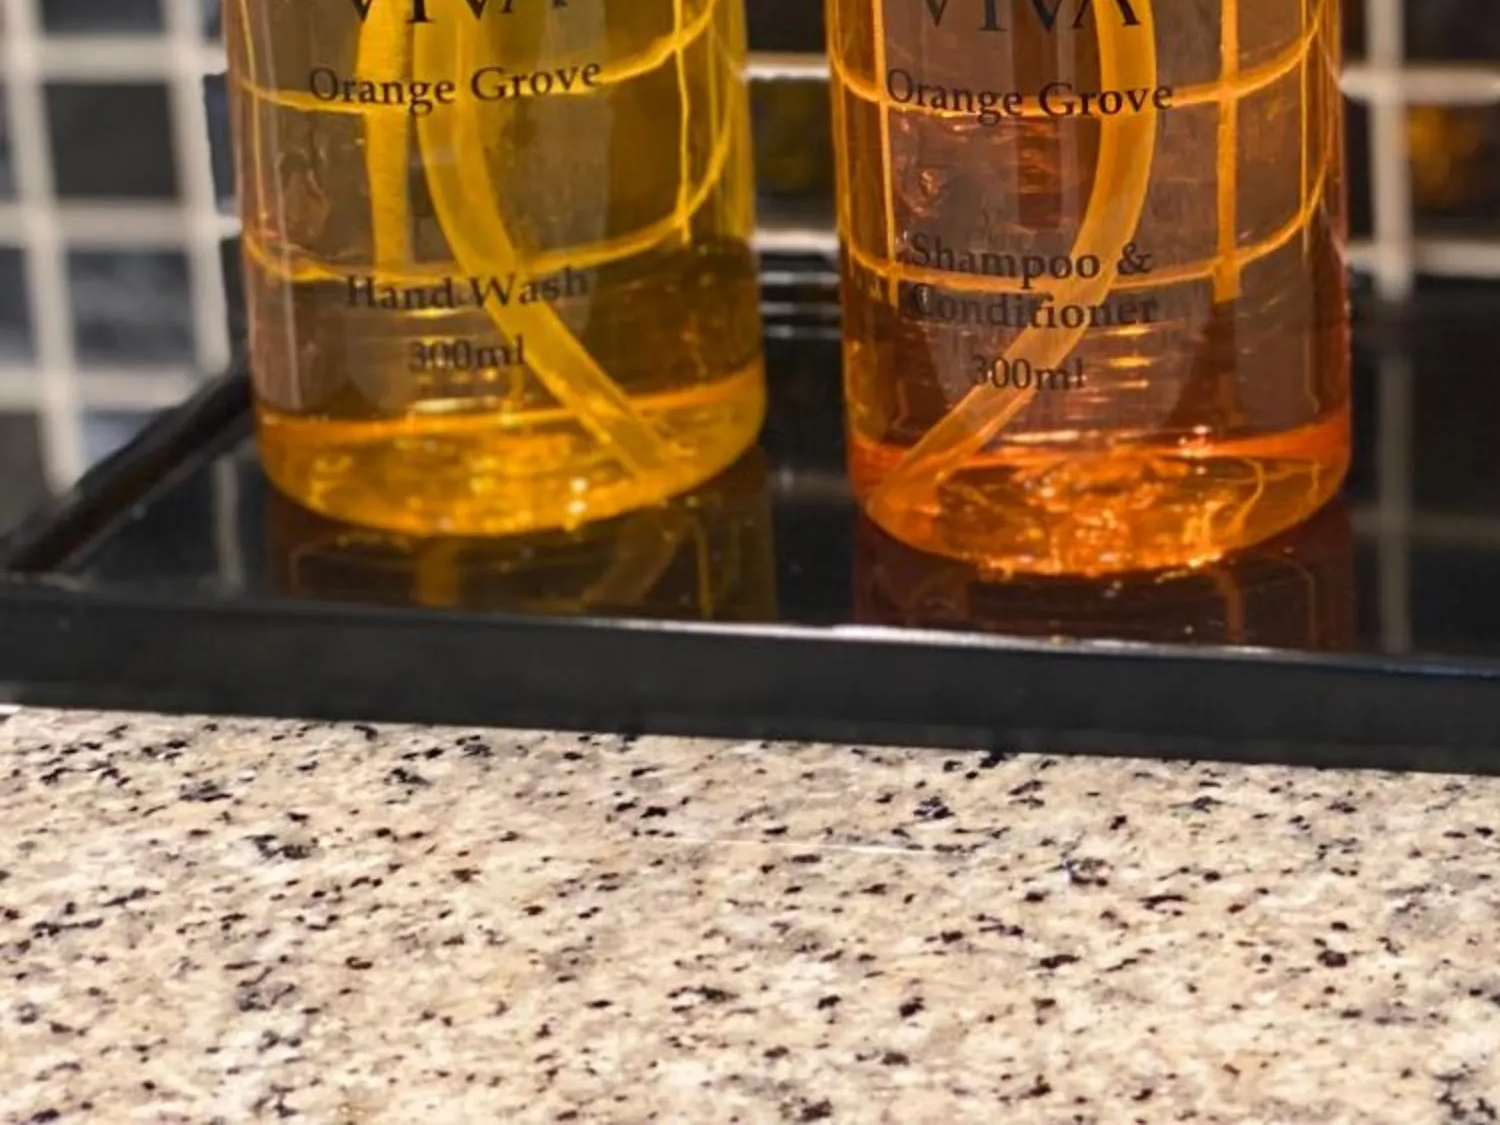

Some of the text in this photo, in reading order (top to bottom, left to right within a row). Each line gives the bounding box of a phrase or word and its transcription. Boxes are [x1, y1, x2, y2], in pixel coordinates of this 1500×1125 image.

[309, 62, 602, 116] Orange Grove
[885, 68, 1174, 126] Orange Grove
[911, 232, 1152, 290] Shampoo &
[345, 265, 589, 310] Hand Wash
[913, 283, 1158, 330] Conditioner
[408, 334, 526, 373] 300ml
[971, 353, 1087, 391] 300ml
